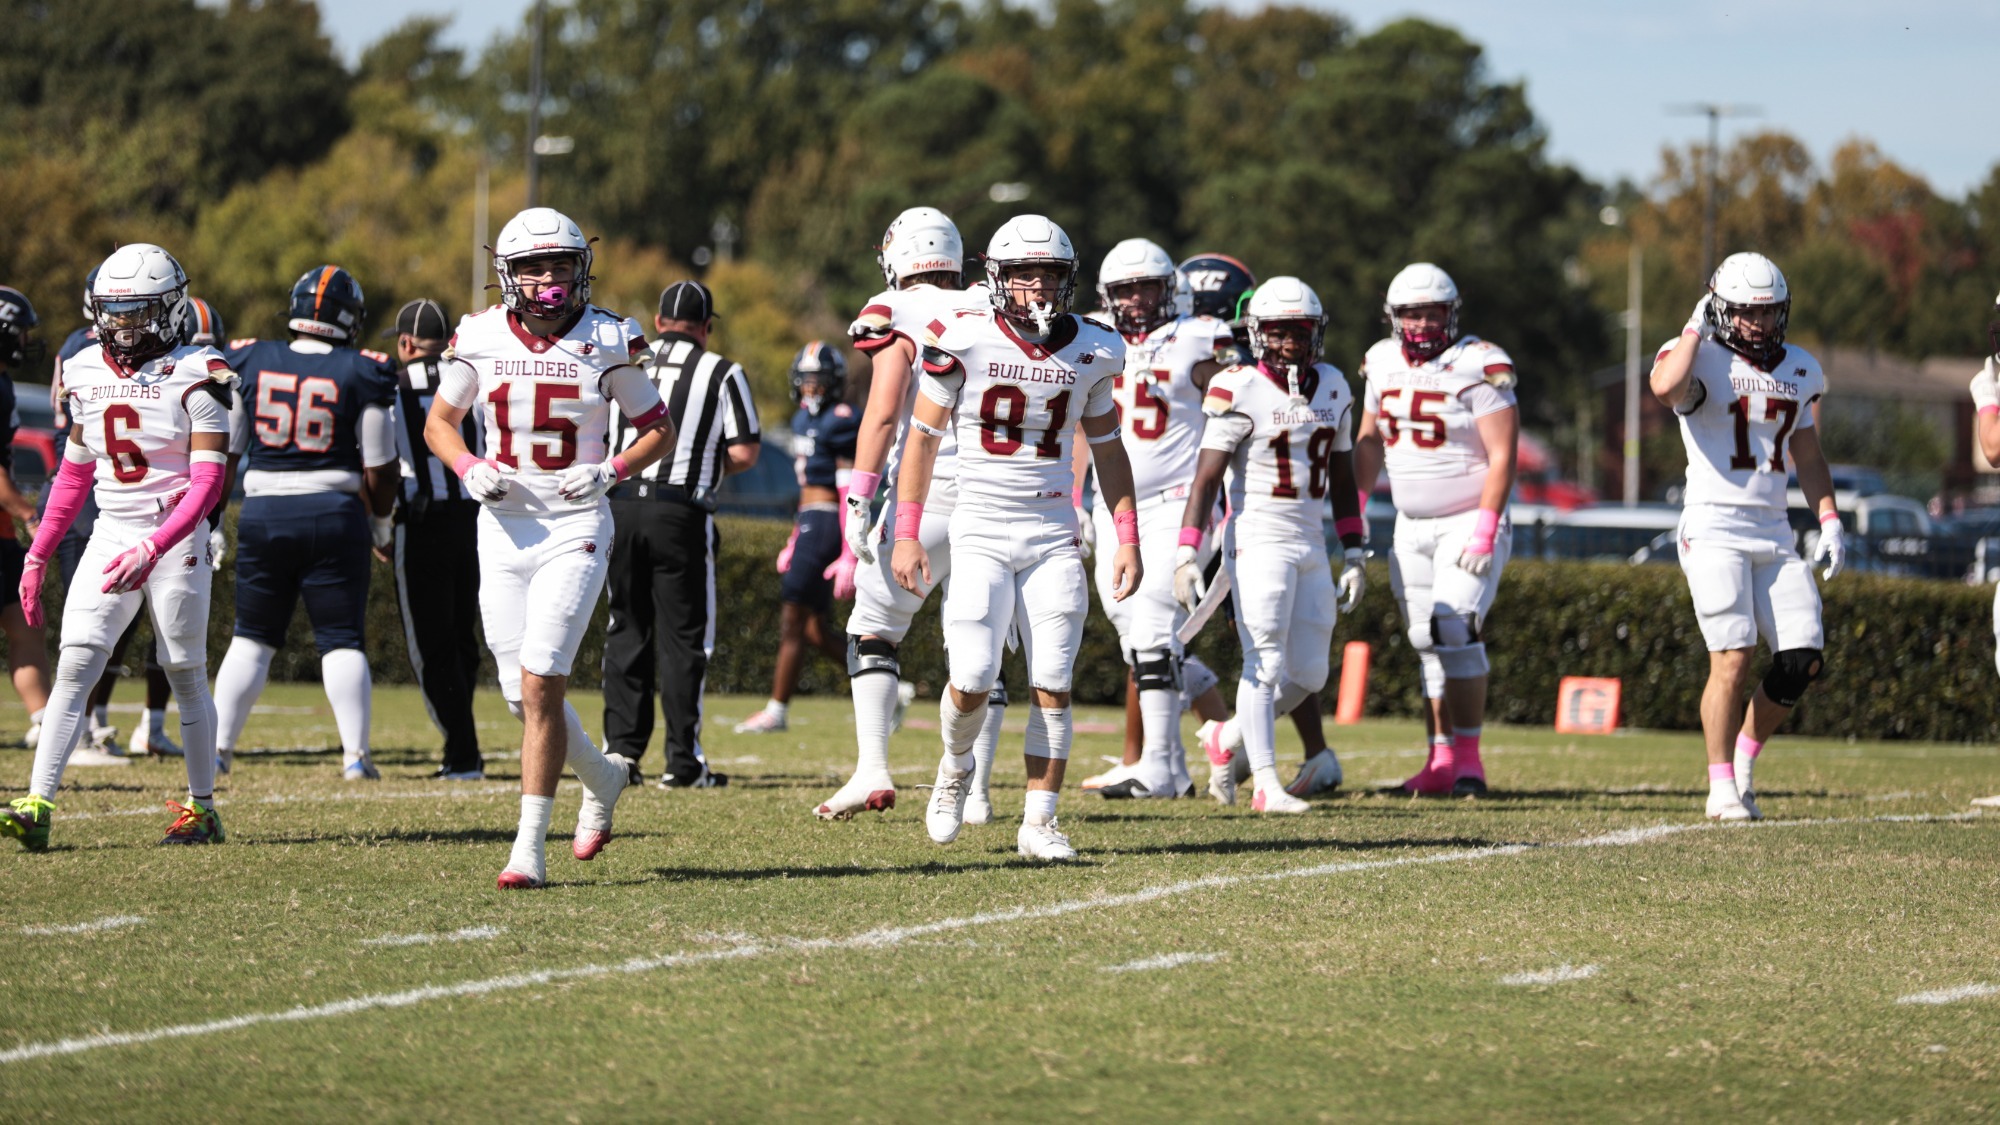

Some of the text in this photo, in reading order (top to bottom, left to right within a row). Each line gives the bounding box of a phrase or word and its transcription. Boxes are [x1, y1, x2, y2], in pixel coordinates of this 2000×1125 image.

[912, 260, 953, 270] Riddell
[297, 322, 334, 337] Riddell
[494, 360, 578, 377] BUILDERS
[988, 362, 1078, 384] BUILDERS
[90, 385, 161, 400] BUILDERS
[1733, 377, 1798, 395] BUILDERS
[255, 370, 339, 453] 56
[980, 384, 1072, 459] 81
[1272, 408, 1335, 425] BUILDERS
[487, 381, 583, 472] 15
[1727, 394, 1799, 474] 17
[103, 402, 152, 486] 6
[1268, 426, 1337, 500] 18
[1569, 688, 1606, 724] G
